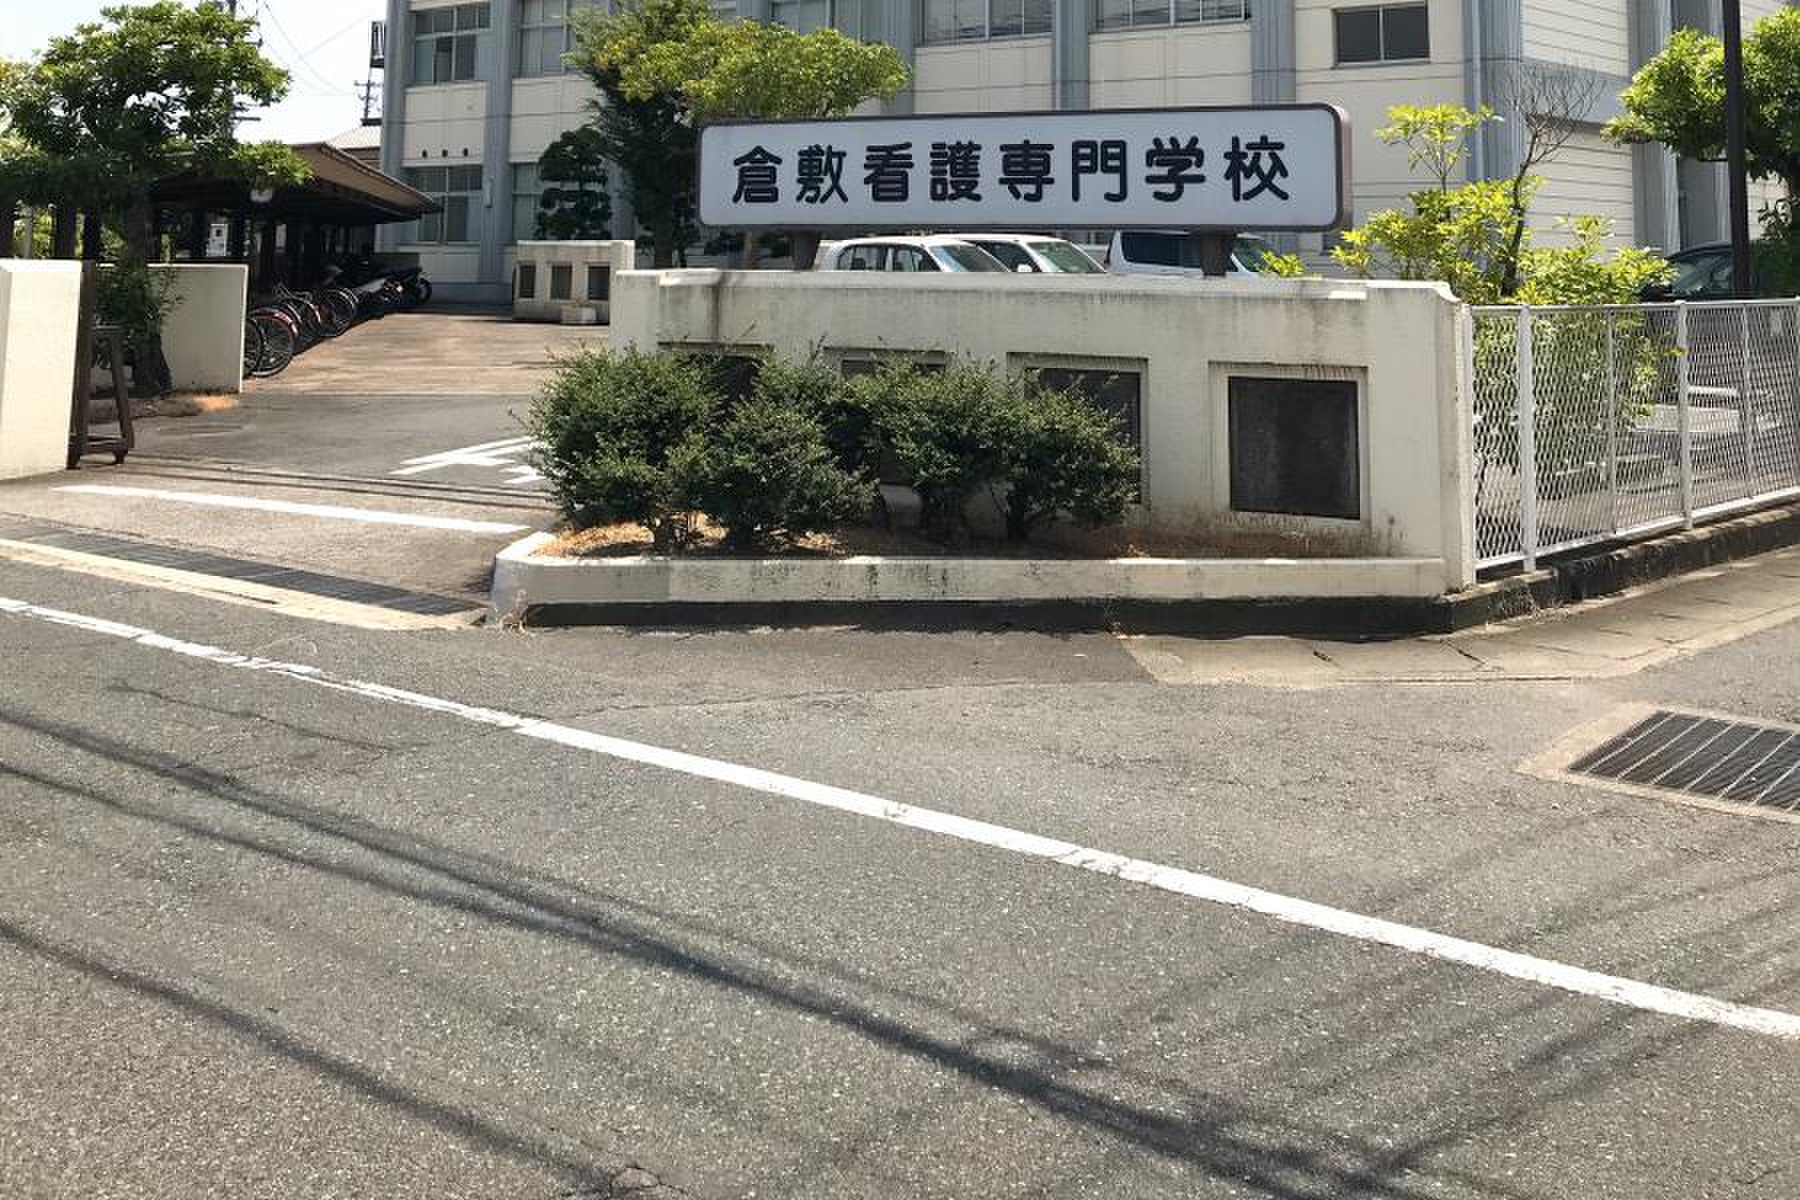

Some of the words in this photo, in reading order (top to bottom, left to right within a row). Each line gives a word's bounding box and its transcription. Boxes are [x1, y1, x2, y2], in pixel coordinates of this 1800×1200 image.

[732, 135, 1289, 204] 倉敷看護専門学校
